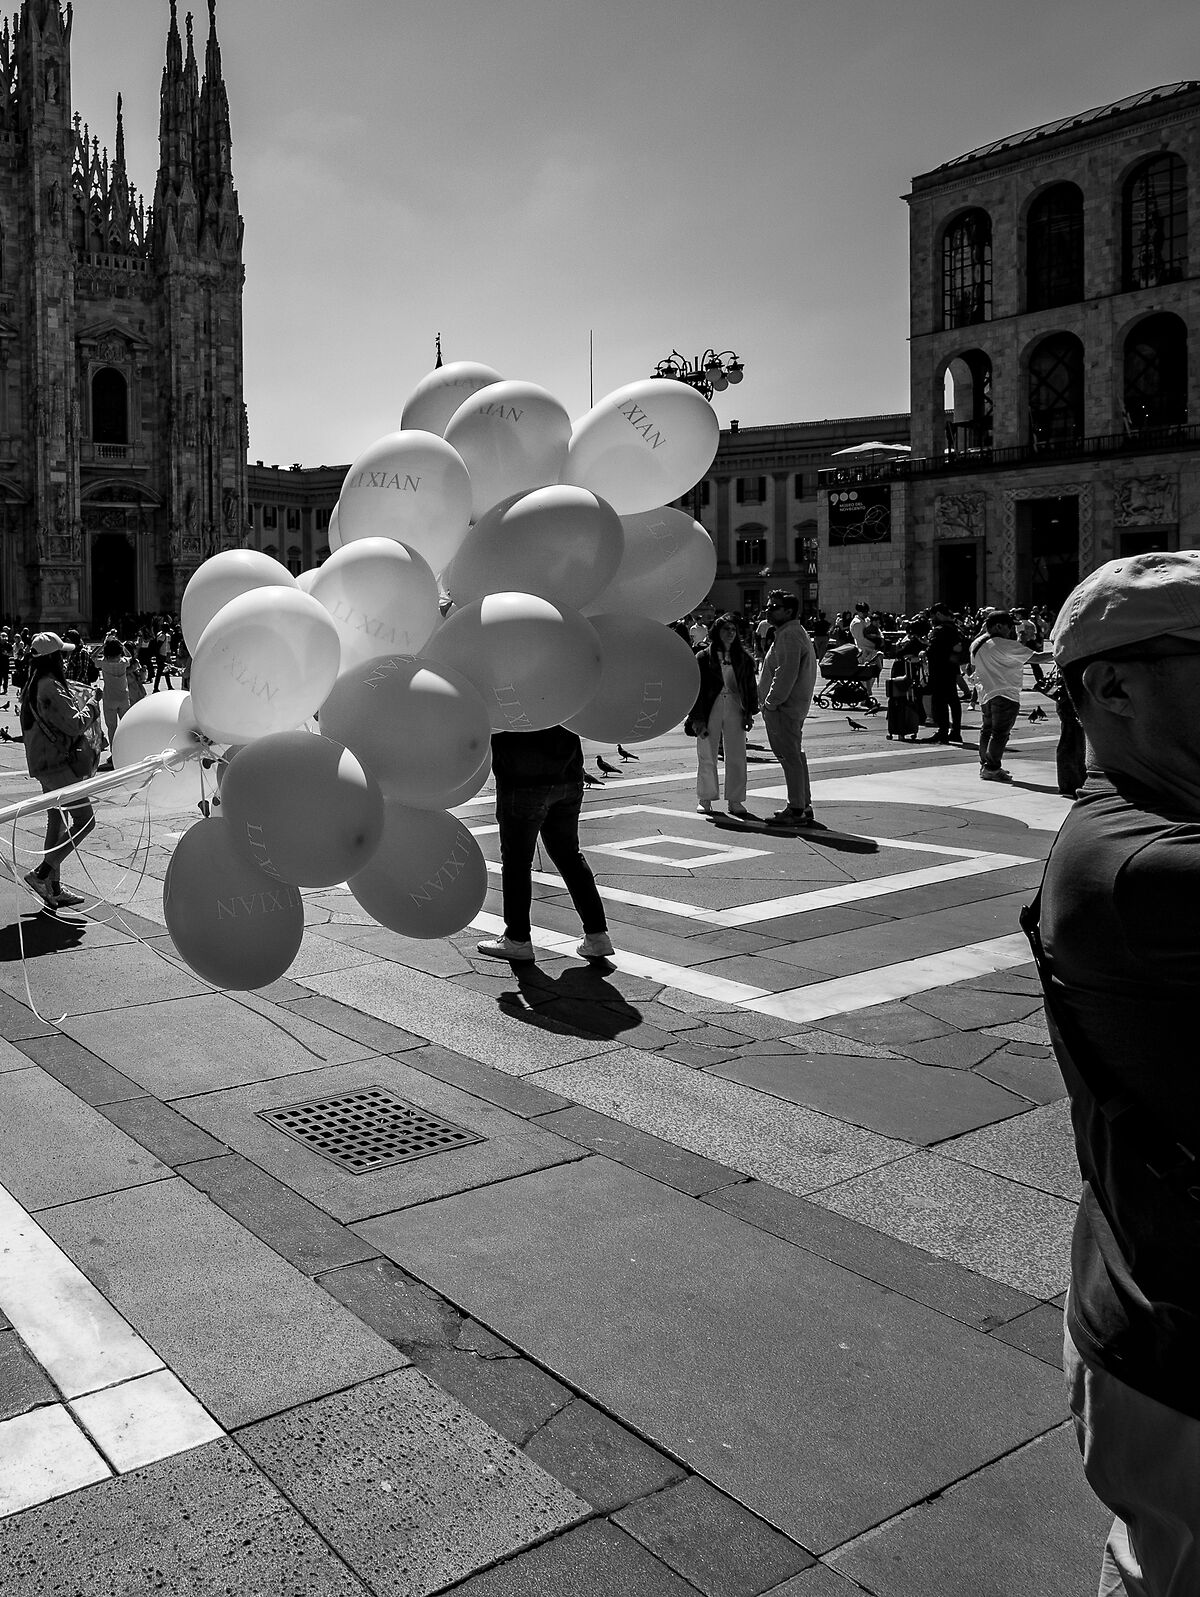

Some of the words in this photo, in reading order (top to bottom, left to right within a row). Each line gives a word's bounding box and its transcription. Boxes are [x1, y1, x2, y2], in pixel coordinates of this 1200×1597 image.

[622, 403, 667, 450] XIAN
[366, 472, 422, 493] XIAN
[830, 491, 858, 506] 900
[493, 682, 522, 709] LI
[642, 680, 664, 703] LI
[247, 821, 267, 851] LI
[408, 849, 467, 909] XIAN
[215, 890, 285, 921] XIAN
